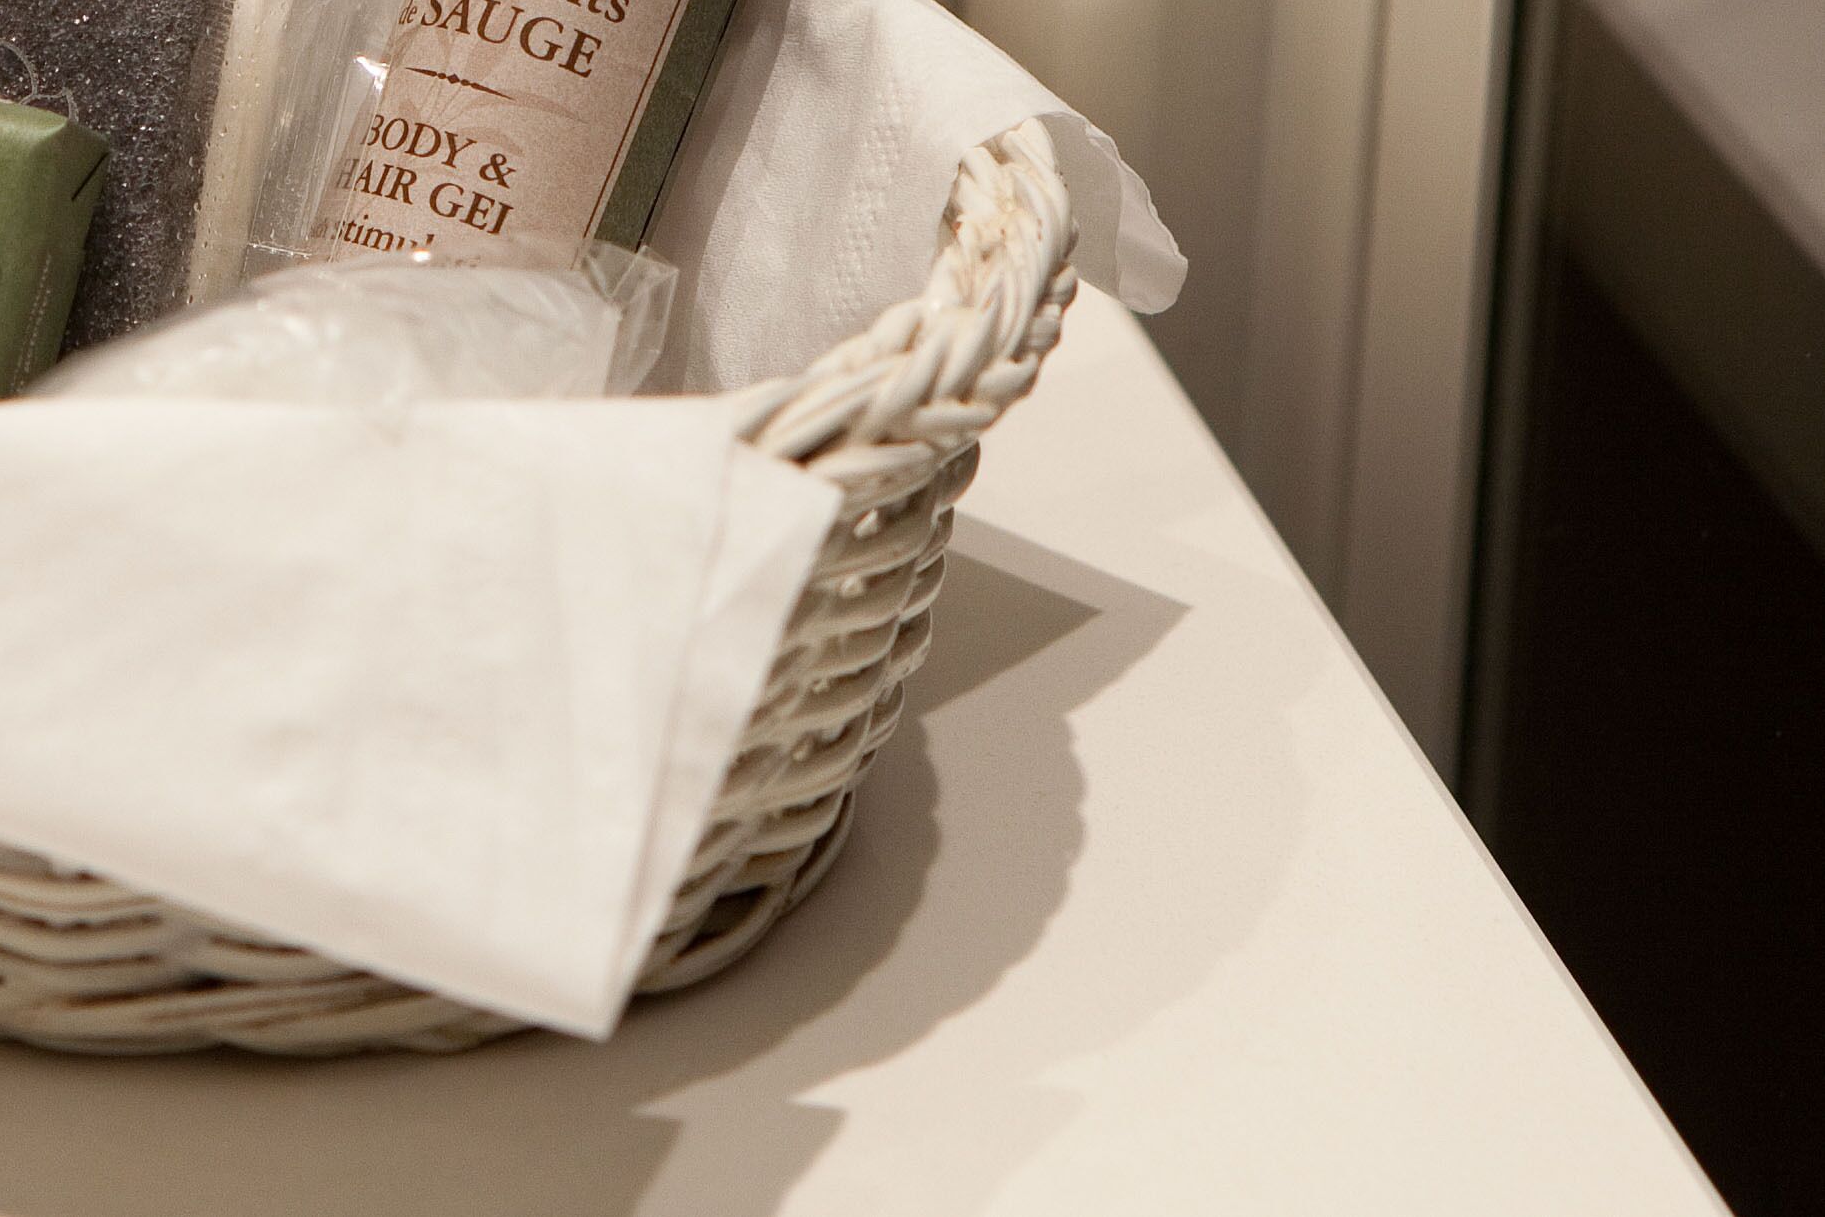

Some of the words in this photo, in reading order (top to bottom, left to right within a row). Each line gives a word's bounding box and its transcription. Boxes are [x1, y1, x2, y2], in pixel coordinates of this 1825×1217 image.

[336, 158, 418, 205] HAIR
[361, 114, 477, 169] BODY
[478, 152, 517, 189] &
